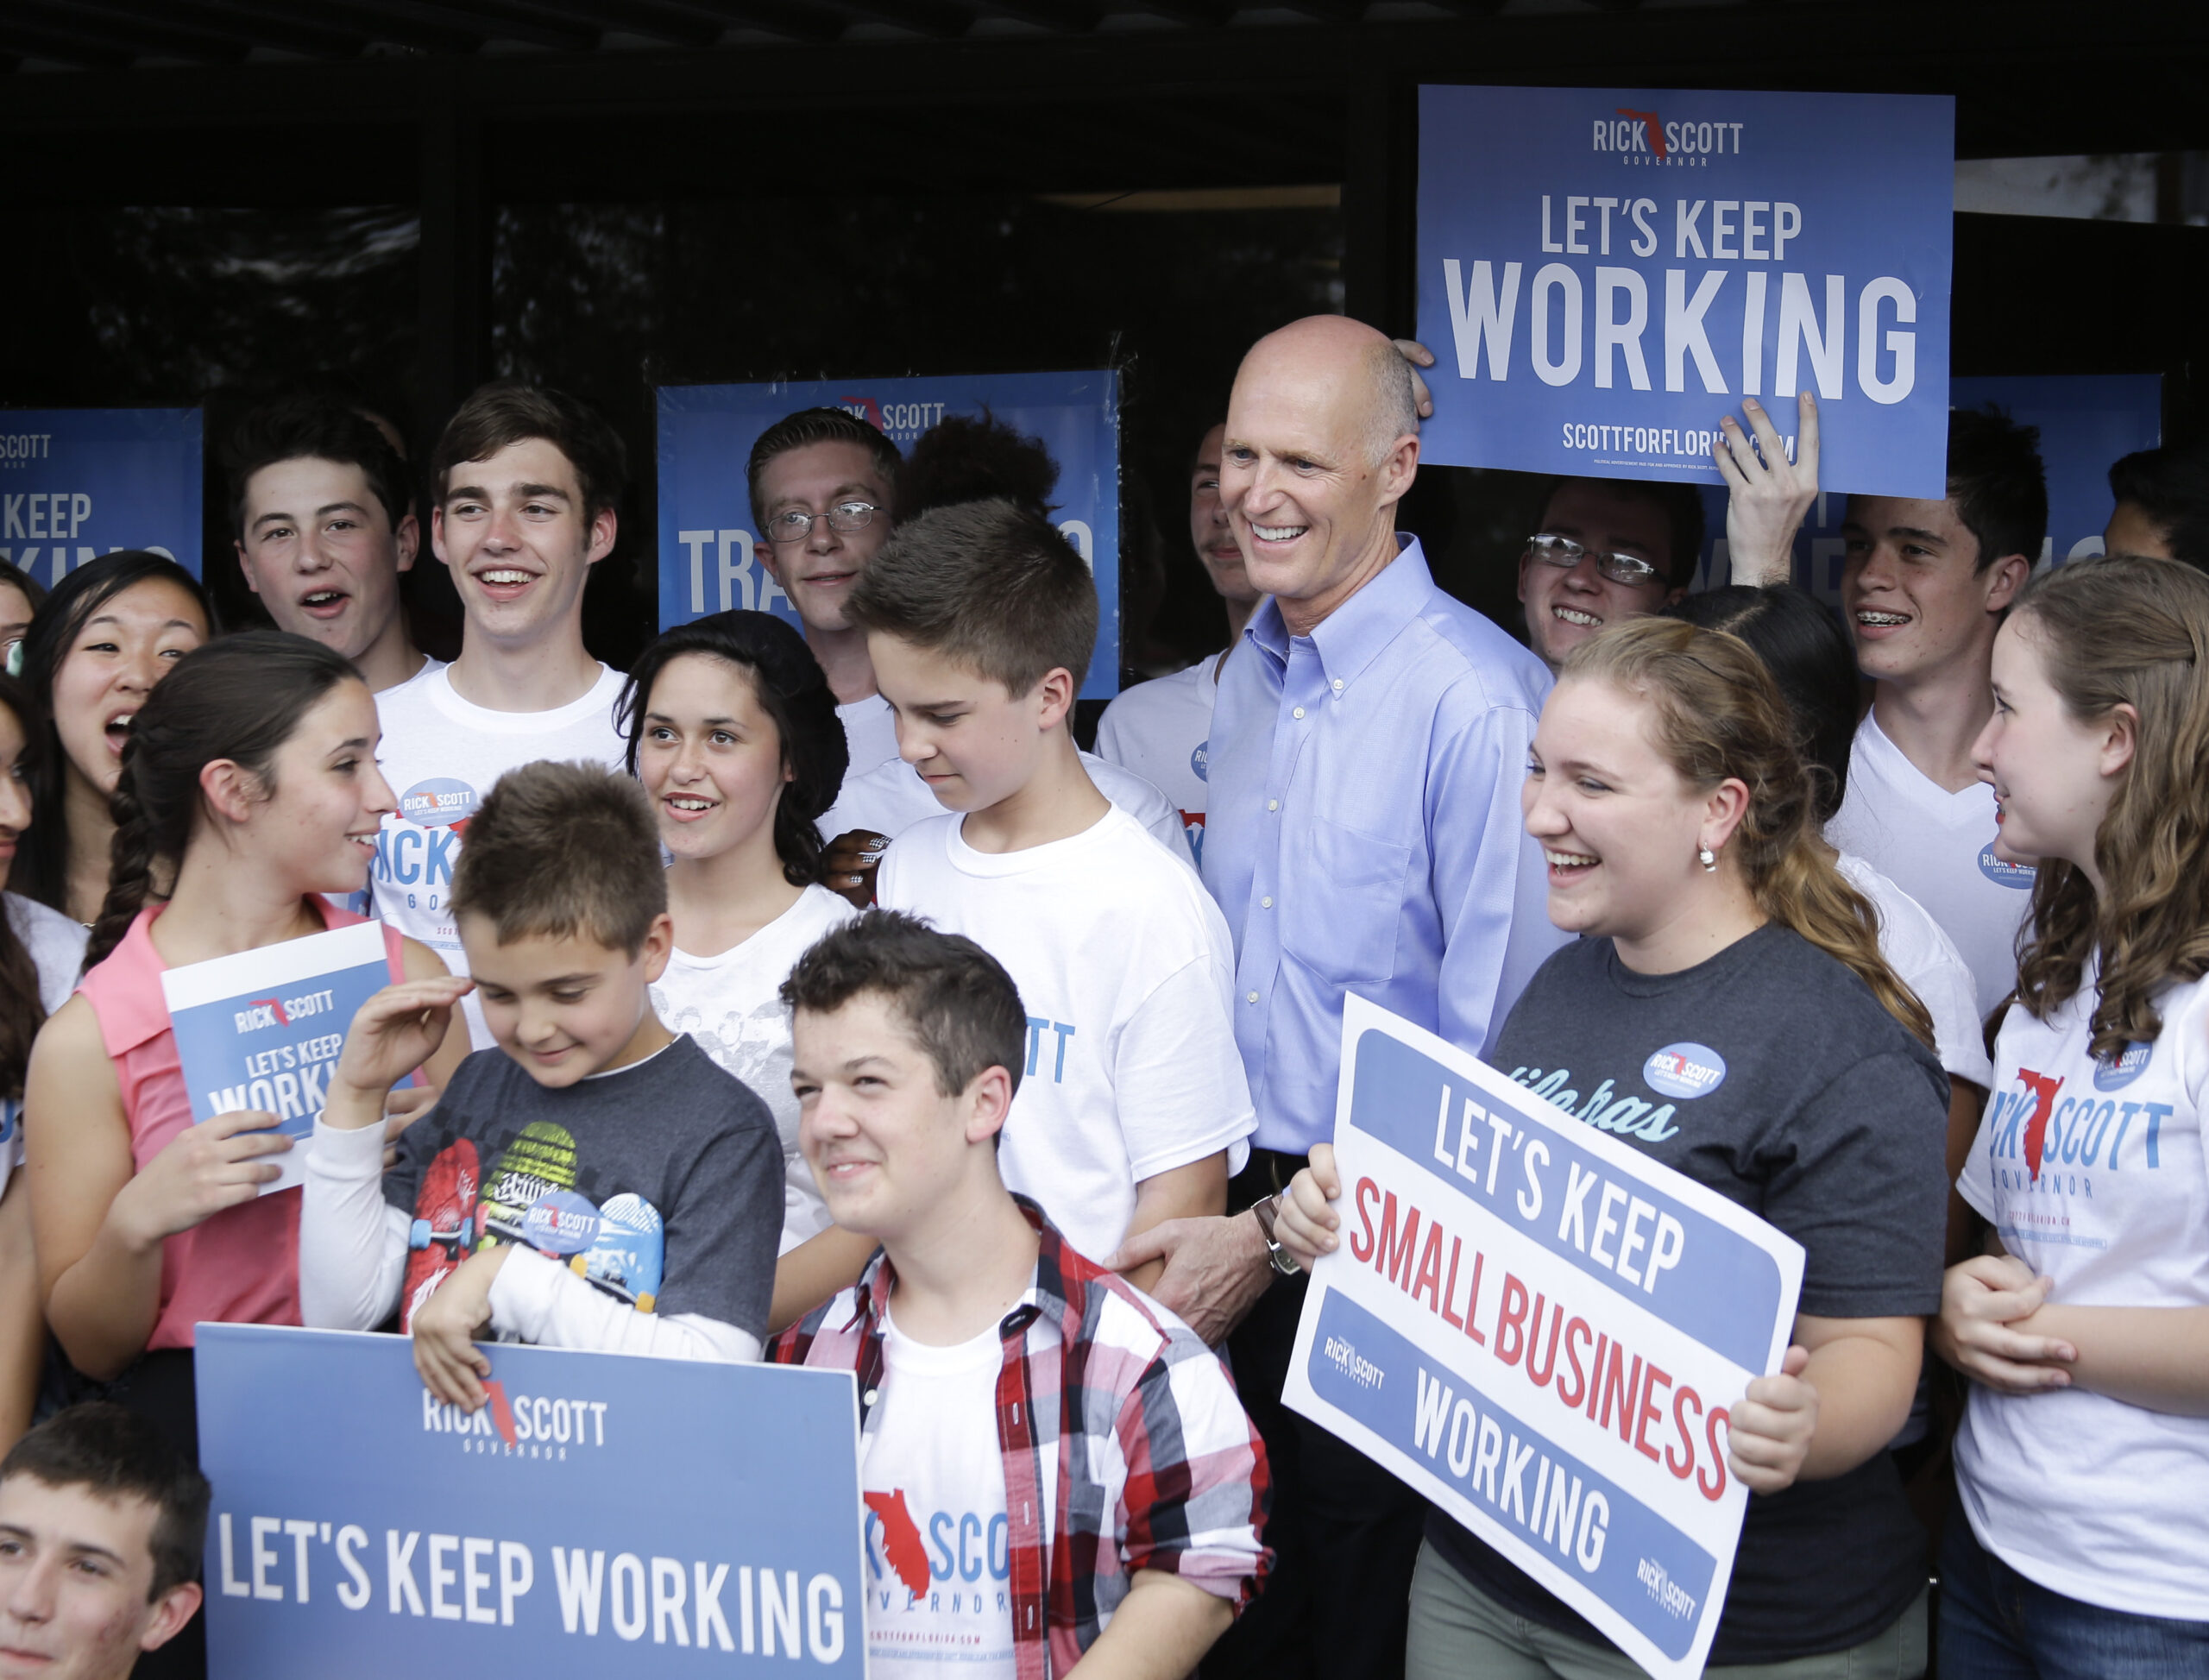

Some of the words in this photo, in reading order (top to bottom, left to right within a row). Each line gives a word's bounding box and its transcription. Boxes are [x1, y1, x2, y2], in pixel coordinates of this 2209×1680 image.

[1593, 120, 1647, 153] RICK
[1665, 121, 1744, 154] SCOTT
[1623, 155, 1707, 167] GOVERNOR
[1541, 195, 1658, 257] LET'S
[1675, 199, 1802, 261] KEEP
[1443, 258, 1917, 405] WORKING
[882, 403, 945, 430] SCOTT
[3, 493, 92, 539] KEEP
[404, 796, 430, 811] RICK
[437, 791, 471, 806] SCOTT
[234, 1004, 276, 1035] RICK
[283, 989, 334, 1022] SCOTT
[245, 1046, 296, 1079] LET'S
[297, 1033, 343, 1065] KEEP
[1650, 1054, 1679, 1073] RICK
[1681, 1061, 1721, 1085] SCOTT
[2042, 1097, 2174, 1170] SCOTT
[1433, 1084, 1551, 1222] LET'S
[1558, 1169, 1684, 1295] KEEP
[527, 1207, 554, 1225] RICK
[557, 1211, 595, 1234] SCOTT
[1325, 1336, 1350, 1367] RICK
[1354, 1355, 1385, 1390] SCOTT
[1349, 1175, 1486, 1348] SMALL
[1493, 1271, 1731, 1502] BUSINESS
[513, 1394, 607, 1446] SCOTT
[463, 1438, 567, 1462] GOVERNOR
[1413, 1367, 1610, 1574] WORKING
[928, 1511, 1010, 1582] SCO
[219, 1513, 371, 1610] LET'S
[386, 1529, 534, 1627] KEEP
[551, 1545, 845, 1665] WORKING
[879, 1589, 1007, 1614] VERNOR
[1637, 1557, 1663, 1593] RICK
[1665, 1580, 1696, 1621] SCOTT
